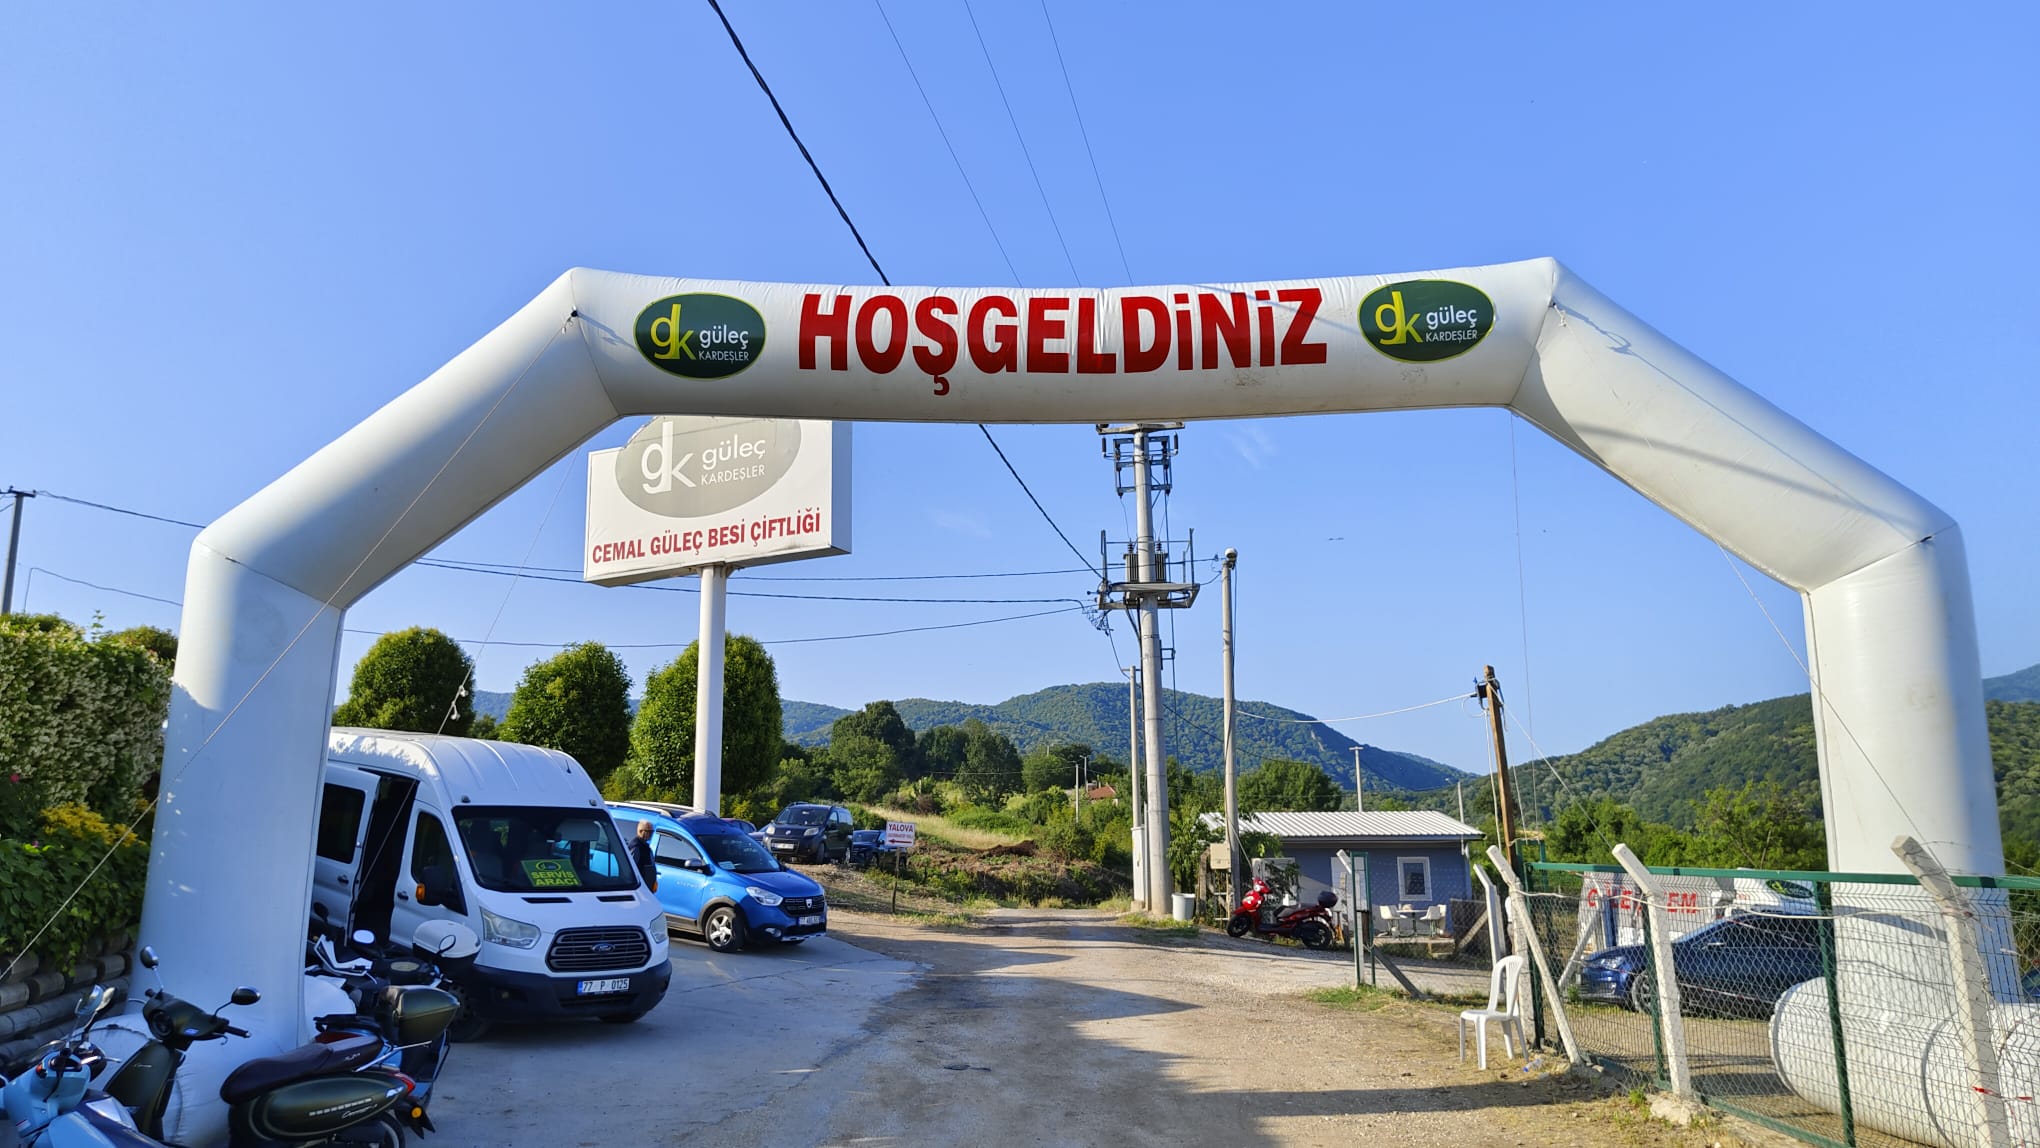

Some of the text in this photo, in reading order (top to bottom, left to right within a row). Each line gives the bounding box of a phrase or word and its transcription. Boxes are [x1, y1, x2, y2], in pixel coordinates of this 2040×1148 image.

[1426, 305, 1478, 330] güleç
[699, 324, 749, 350] güleç
[1425, 329, 1478, 344] KARDEŞLER
[698, 350, 749, 365] KARDEŞLER
[702, 433, 766, 470] güleç
[592, 507, 821, 563] CEMAL GÜLEÇ BESİ ÇİFTLİĞİ
[888, 823, 914, 833] YALOVA
[530, 869, 575, 879] SERVİS
[535, 878, 579, 886] ARACI
[583, 981, 593, 991] 77
[600, 980, 606, 991] P
